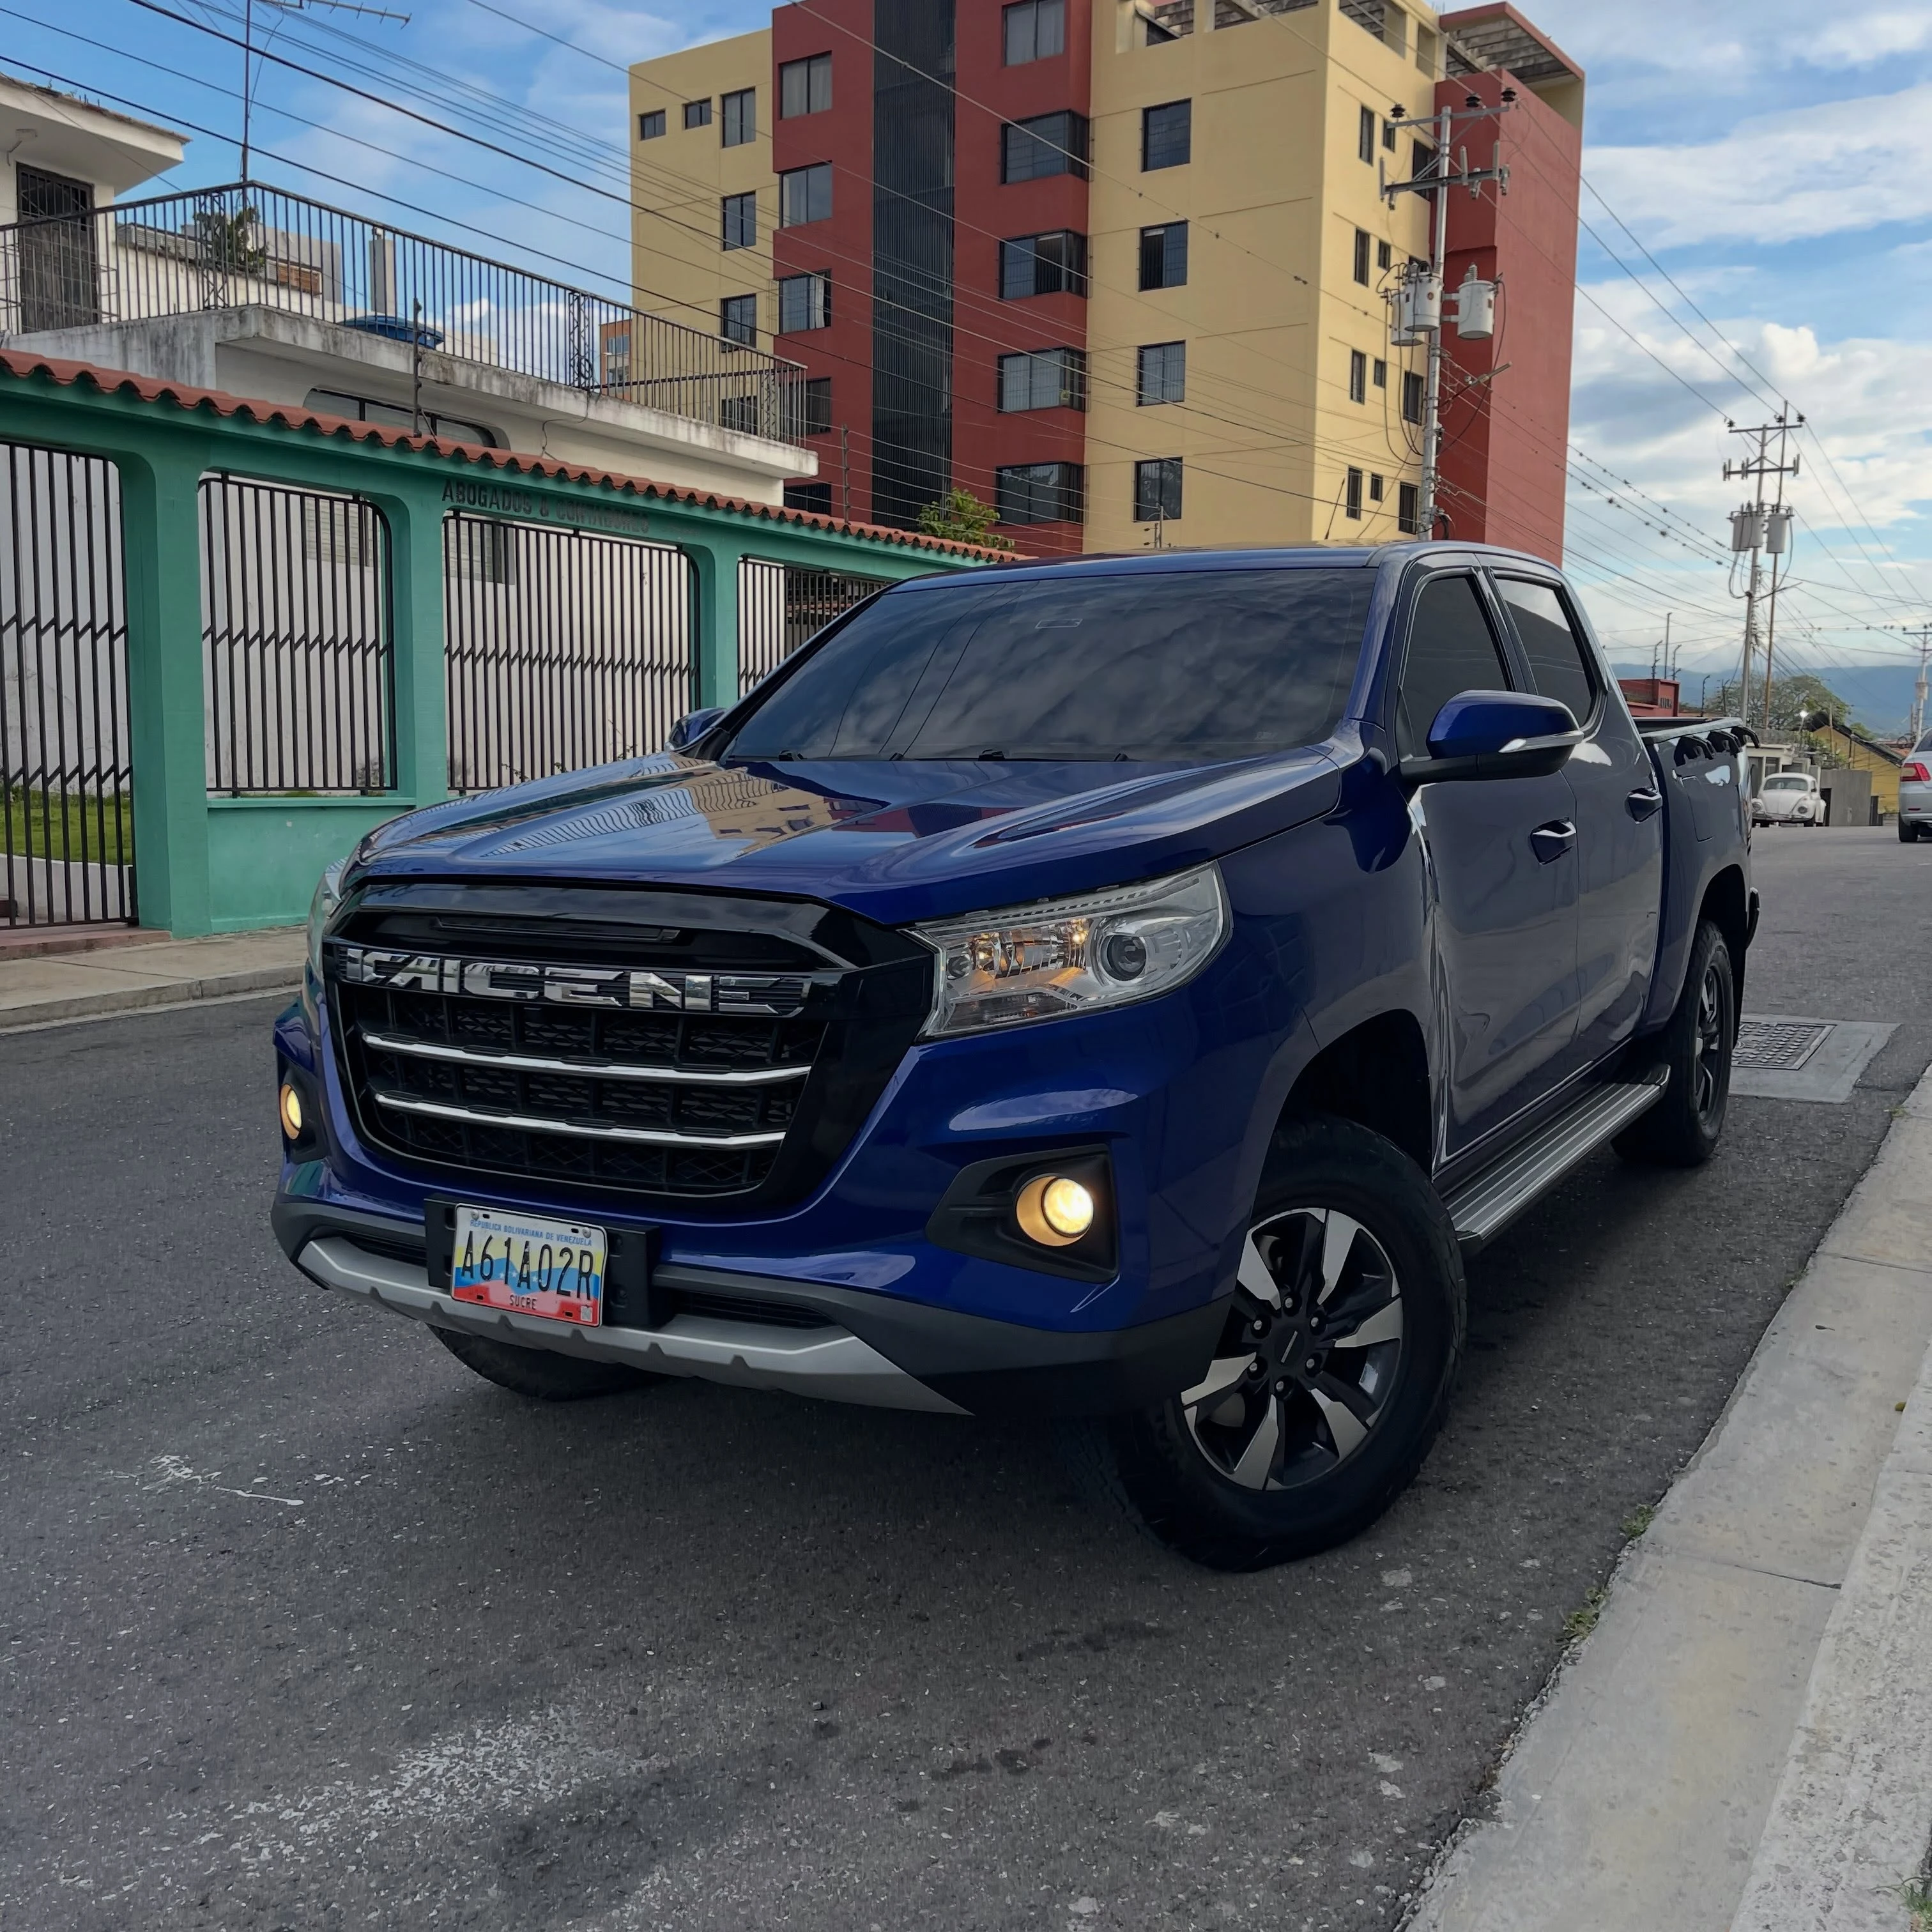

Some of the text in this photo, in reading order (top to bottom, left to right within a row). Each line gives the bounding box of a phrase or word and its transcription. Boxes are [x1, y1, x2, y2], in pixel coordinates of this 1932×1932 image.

[442, 478, 532, 515] ABOGADOS
[346, 948, 783, 1016] KAICENE
[503, 1225, 543, 1239] BOLIVARIANA
[546, 1232, 554, 1241] DE
[556, 1234, 592, 1246] VENEZUELA
[461, 1230, 594, 1301] A61A02R
[510, 1294, 537, 1310] SUCRE
